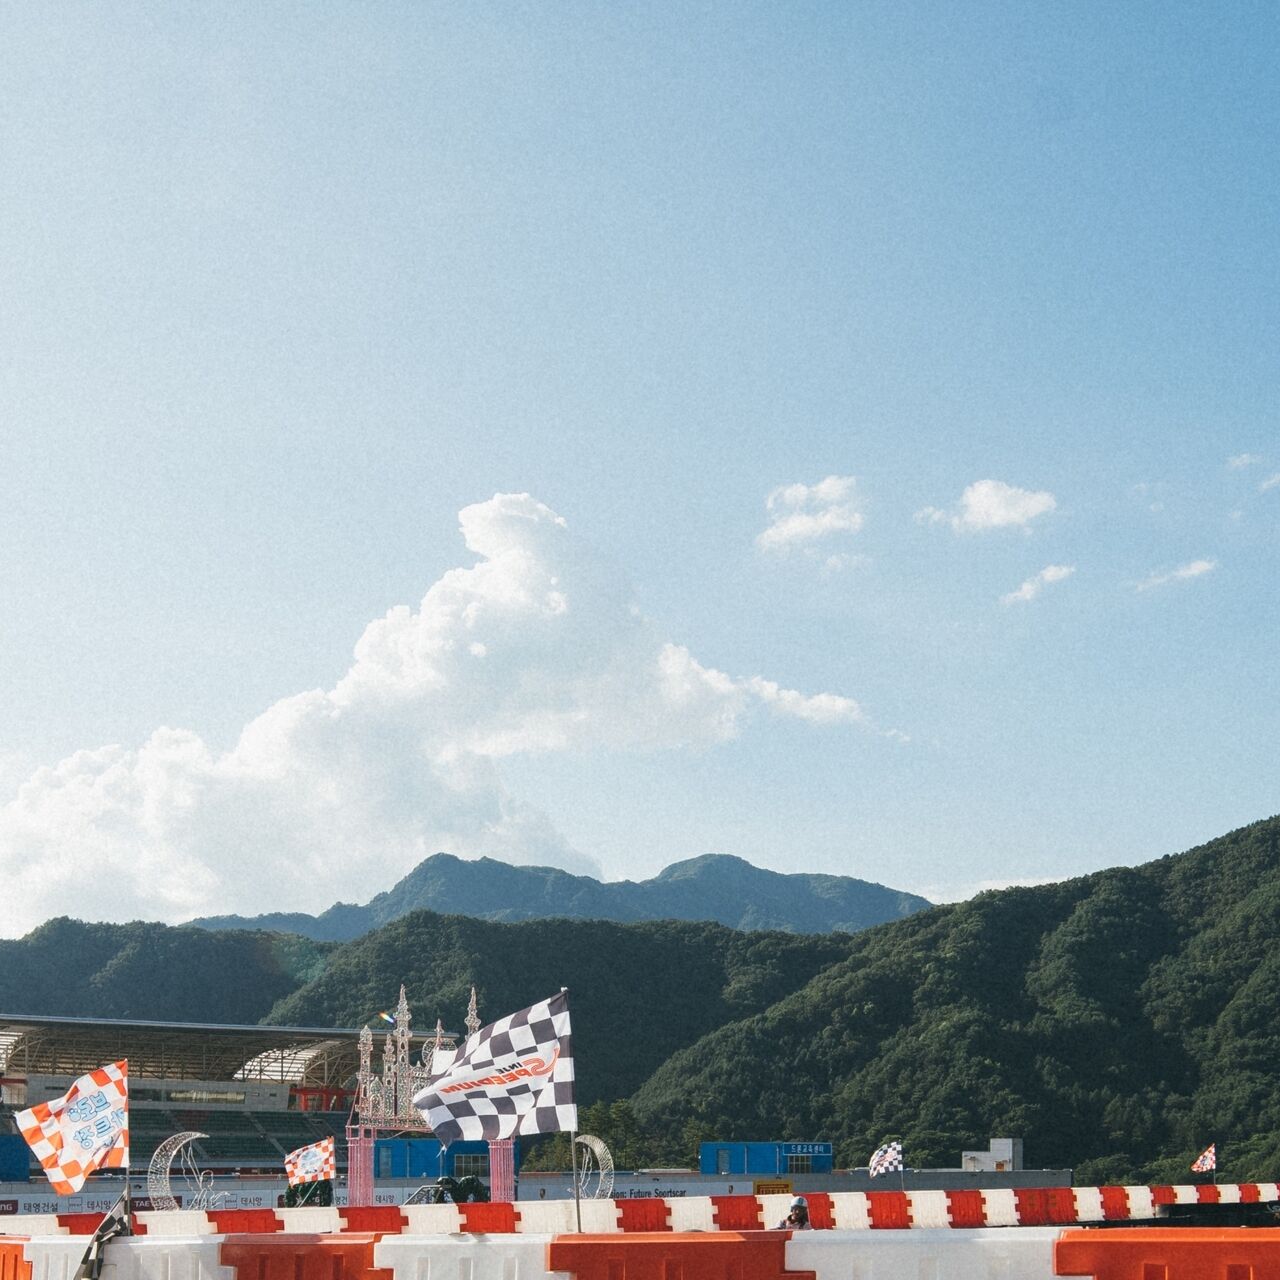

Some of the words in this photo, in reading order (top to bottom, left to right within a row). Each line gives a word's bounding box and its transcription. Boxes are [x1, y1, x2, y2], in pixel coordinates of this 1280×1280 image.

[629, 1189, 652, 1198] Future
[654, 1188, 686, 1198] Sportscar
[23, 1202, 59, 1213] 태영건설
[87, 1200, 111, 1210] 데시앙
